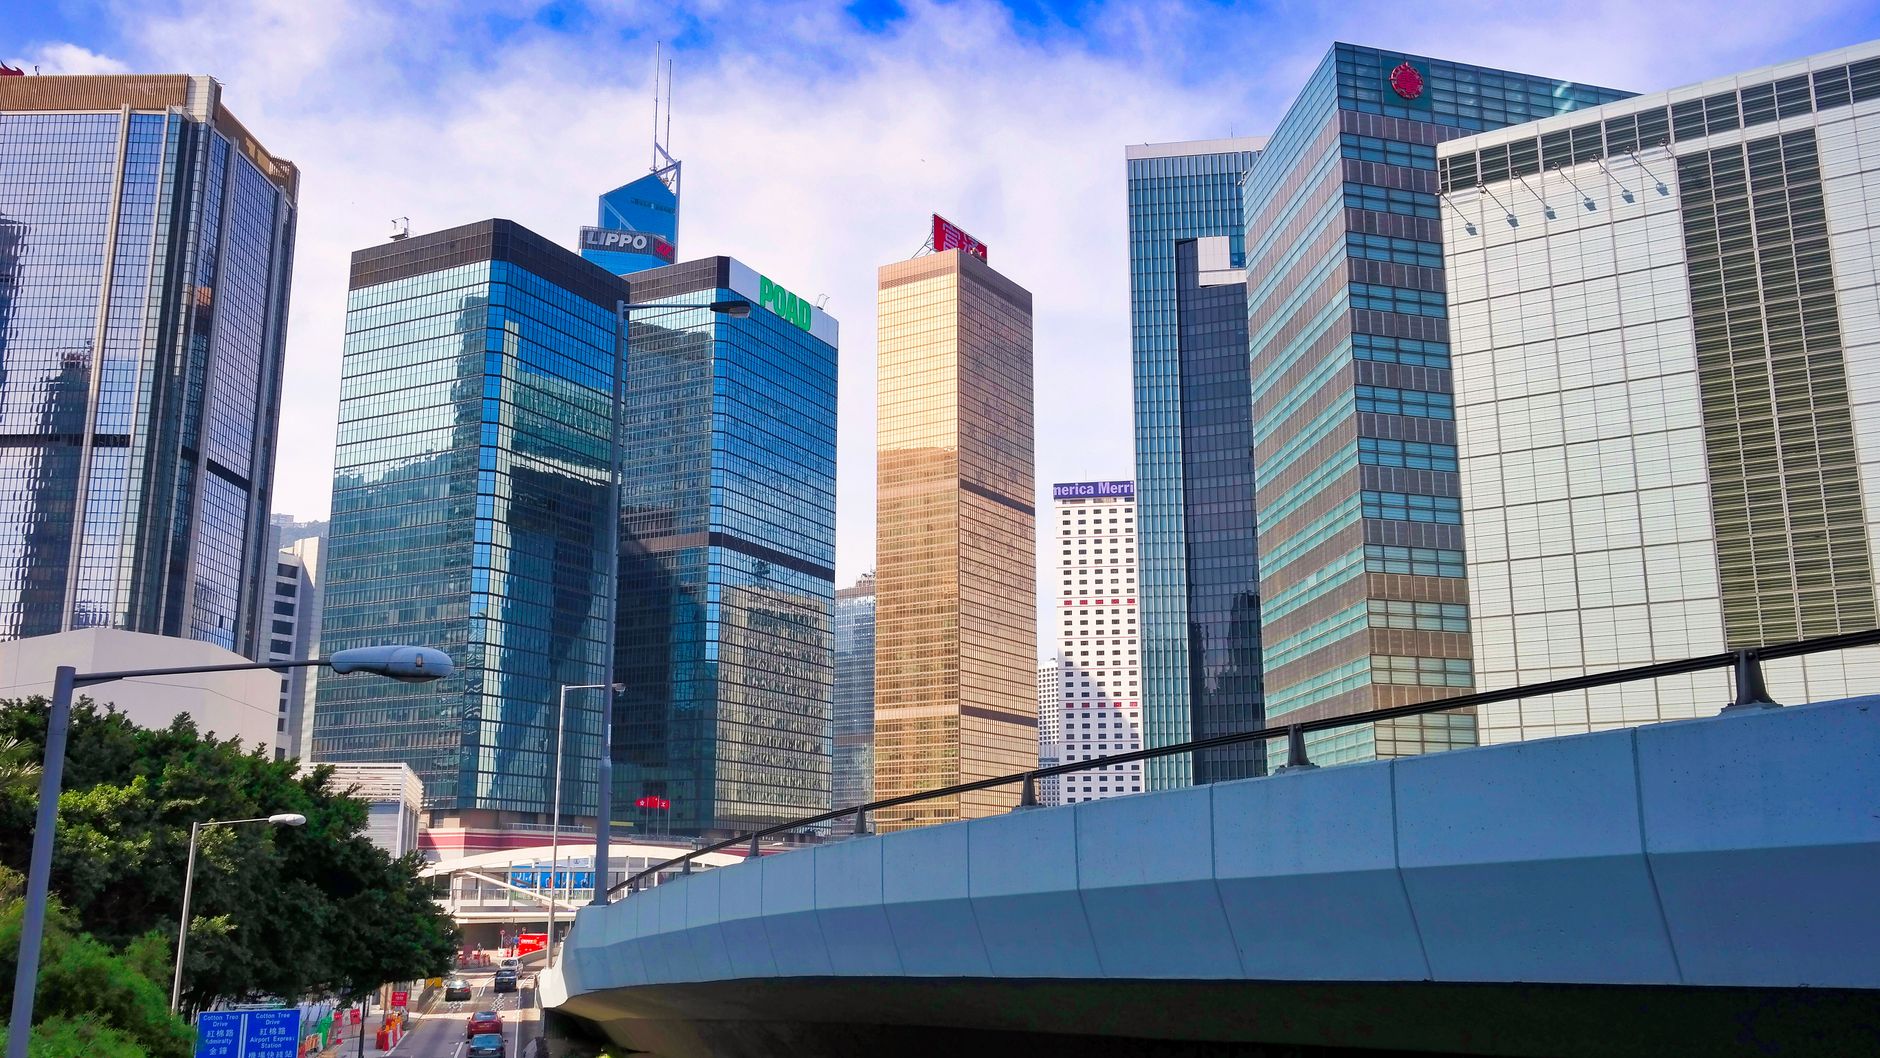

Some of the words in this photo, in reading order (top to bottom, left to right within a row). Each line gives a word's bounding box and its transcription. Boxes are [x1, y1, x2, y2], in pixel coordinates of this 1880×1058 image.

[587, 231, 647, 250] LIPPO
[759, 275, 812, 332] POAD
[1098, 481, 1134, 494] Merri
